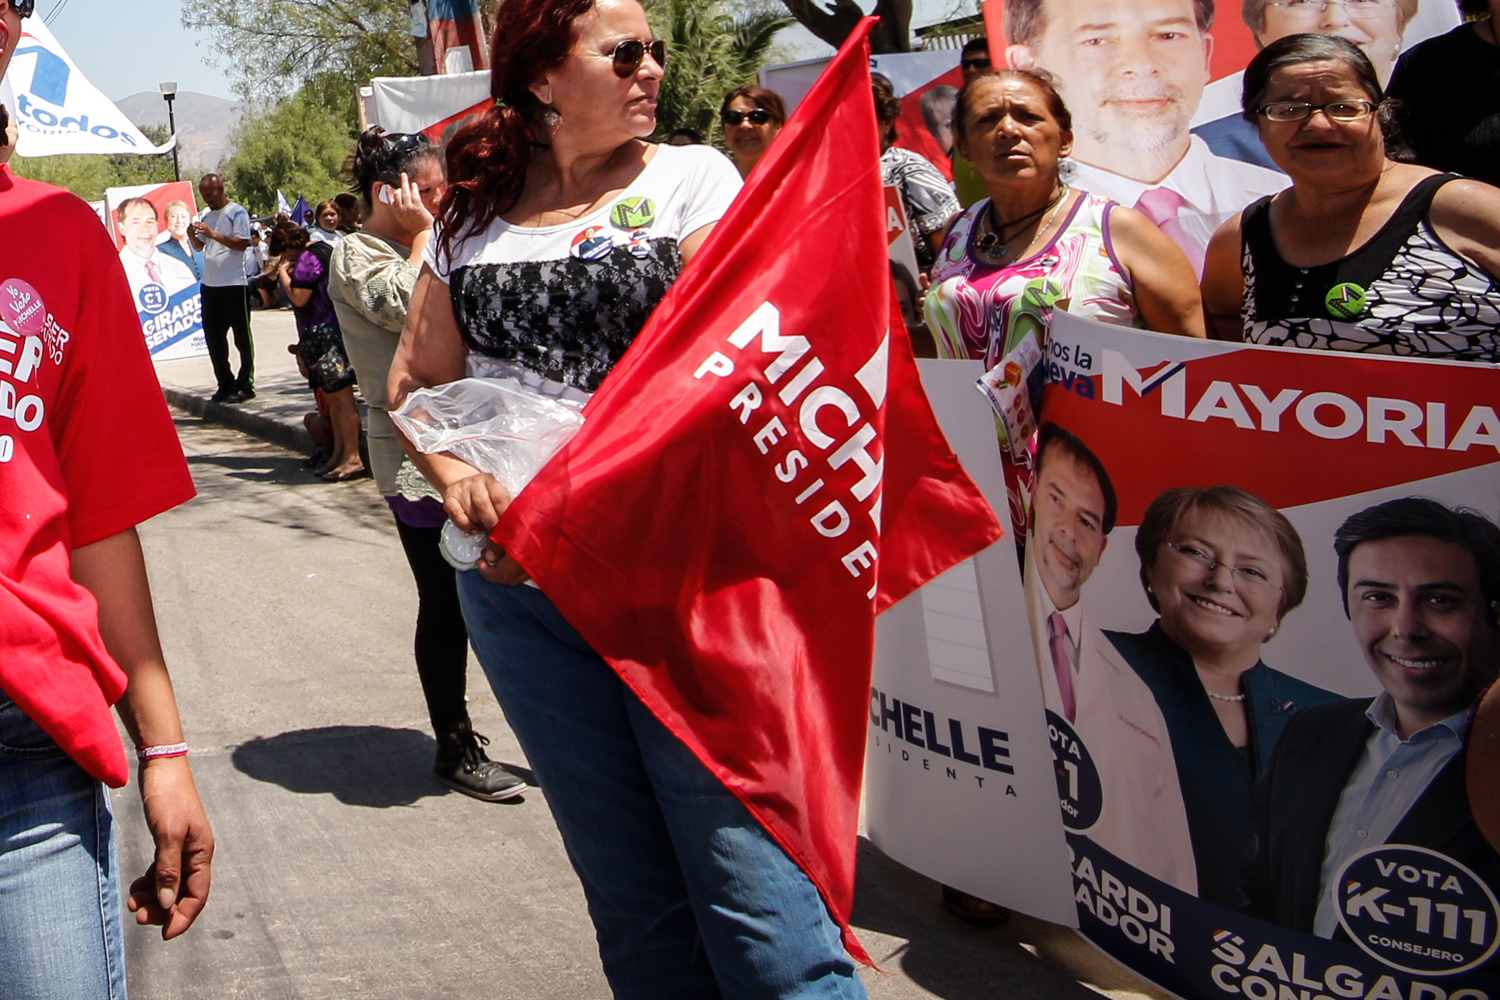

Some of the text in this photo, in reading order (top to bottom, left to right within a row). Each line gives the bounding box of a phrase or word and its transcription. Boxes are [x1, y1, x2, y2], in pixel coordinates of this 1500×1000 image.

[17, 94, 137, 147] todos
[6, 285, 18, 299] Yo
[9, 292, 31, 313] Voto
[13, 299, 43, 326] MICHELLE
[142, 293, 202, 336] GIRARD
[145, 309, 203, 351] SENADO
[1074, 345, 1092, 370] la
[727, 301, 884, 515] MICH
[1102, 348, 1500, 452] MAYORIA
[693, 351, 878, 590] PRESIDE
[870, 686, 1014, 775] CHELLE
[1048, 724, 1082, 760] OTA
[870, 732, 1017, 798] SIDENTA
[1061, 799, 1078, 818] dor
[1375, 858, 1464, 895] VOTA
[1075, 883, 1175, 965] ADOR
[1347, 880, 1486, 946] K-111
[1368, 934, 1464, 963] CONSEJERO
